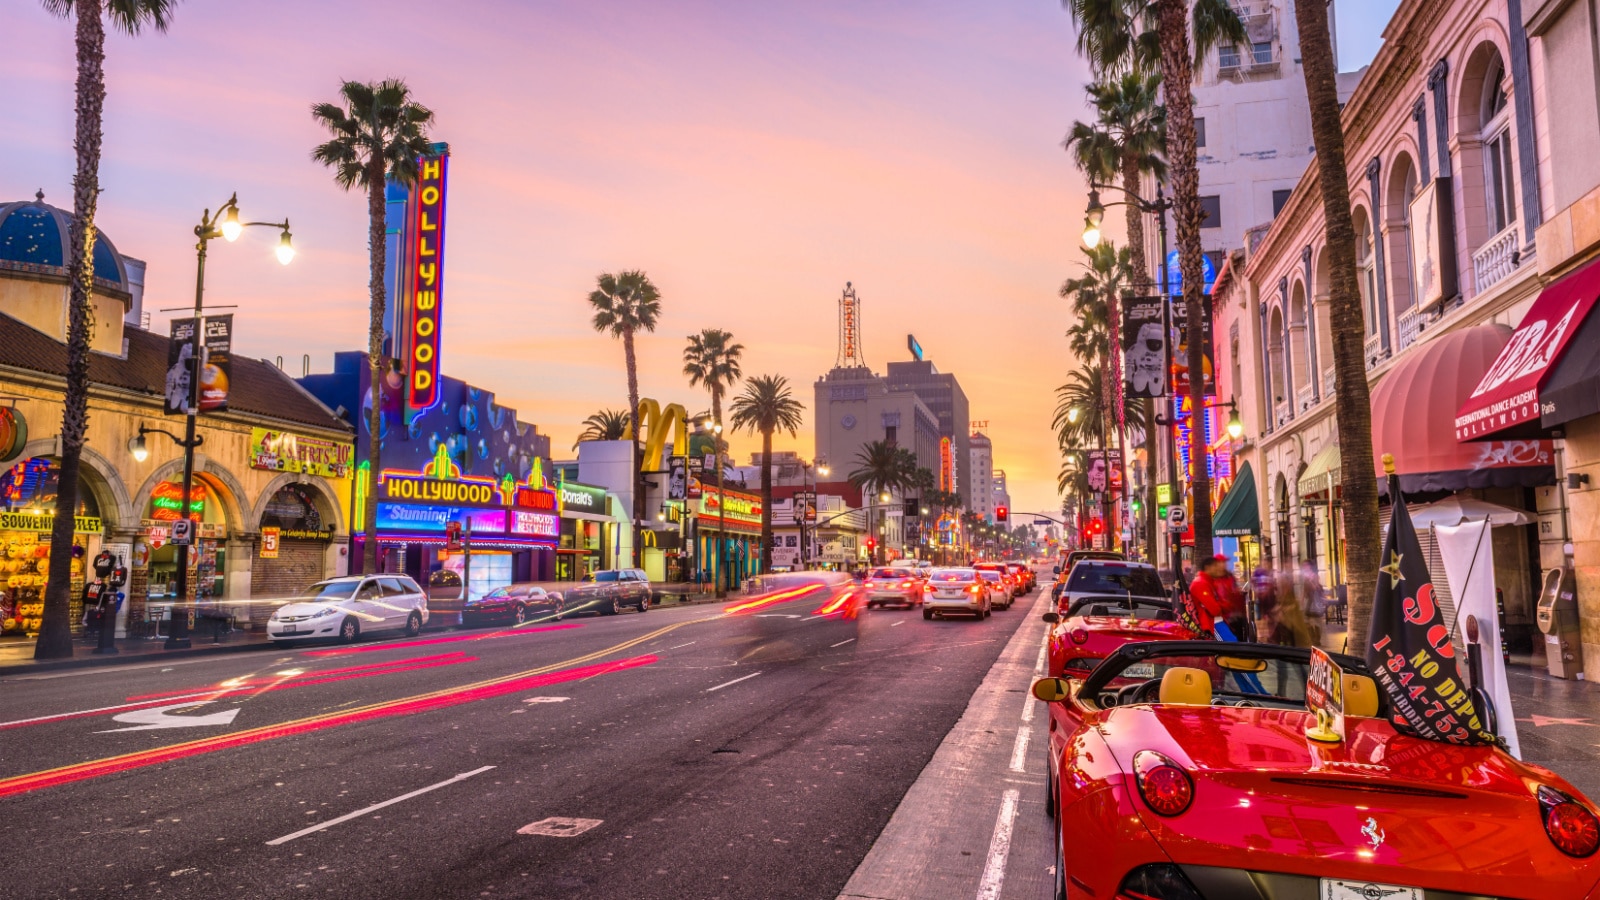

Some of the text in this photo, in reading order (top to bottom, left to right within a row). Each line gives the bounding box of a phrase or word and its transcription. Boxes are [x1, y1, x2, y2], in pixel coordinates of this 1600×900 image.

[414, 160, 440, 391] HOLLYWOOD
[1129, 307, 1206, 320] SPAC
[174, 326, 229, 340] SPCE
[1455, 388, 1537, 427] INTERNATIONAL DANCE ACADEMY
[1541, 401, 1556, 416] Paris
[1456, 403, 1539, 440] HOLLYWOOD
[387, 478, 492, 503] HOLLYWOOD
[1298, 476, 1319, 496] BAKERY
[561, 489, 593, 506] Donald's
[1, 514, 100, 532] SOUVENI TLET
[151, 527, 166, 538] ATM
[1409, 648, 1440, 679] NO
